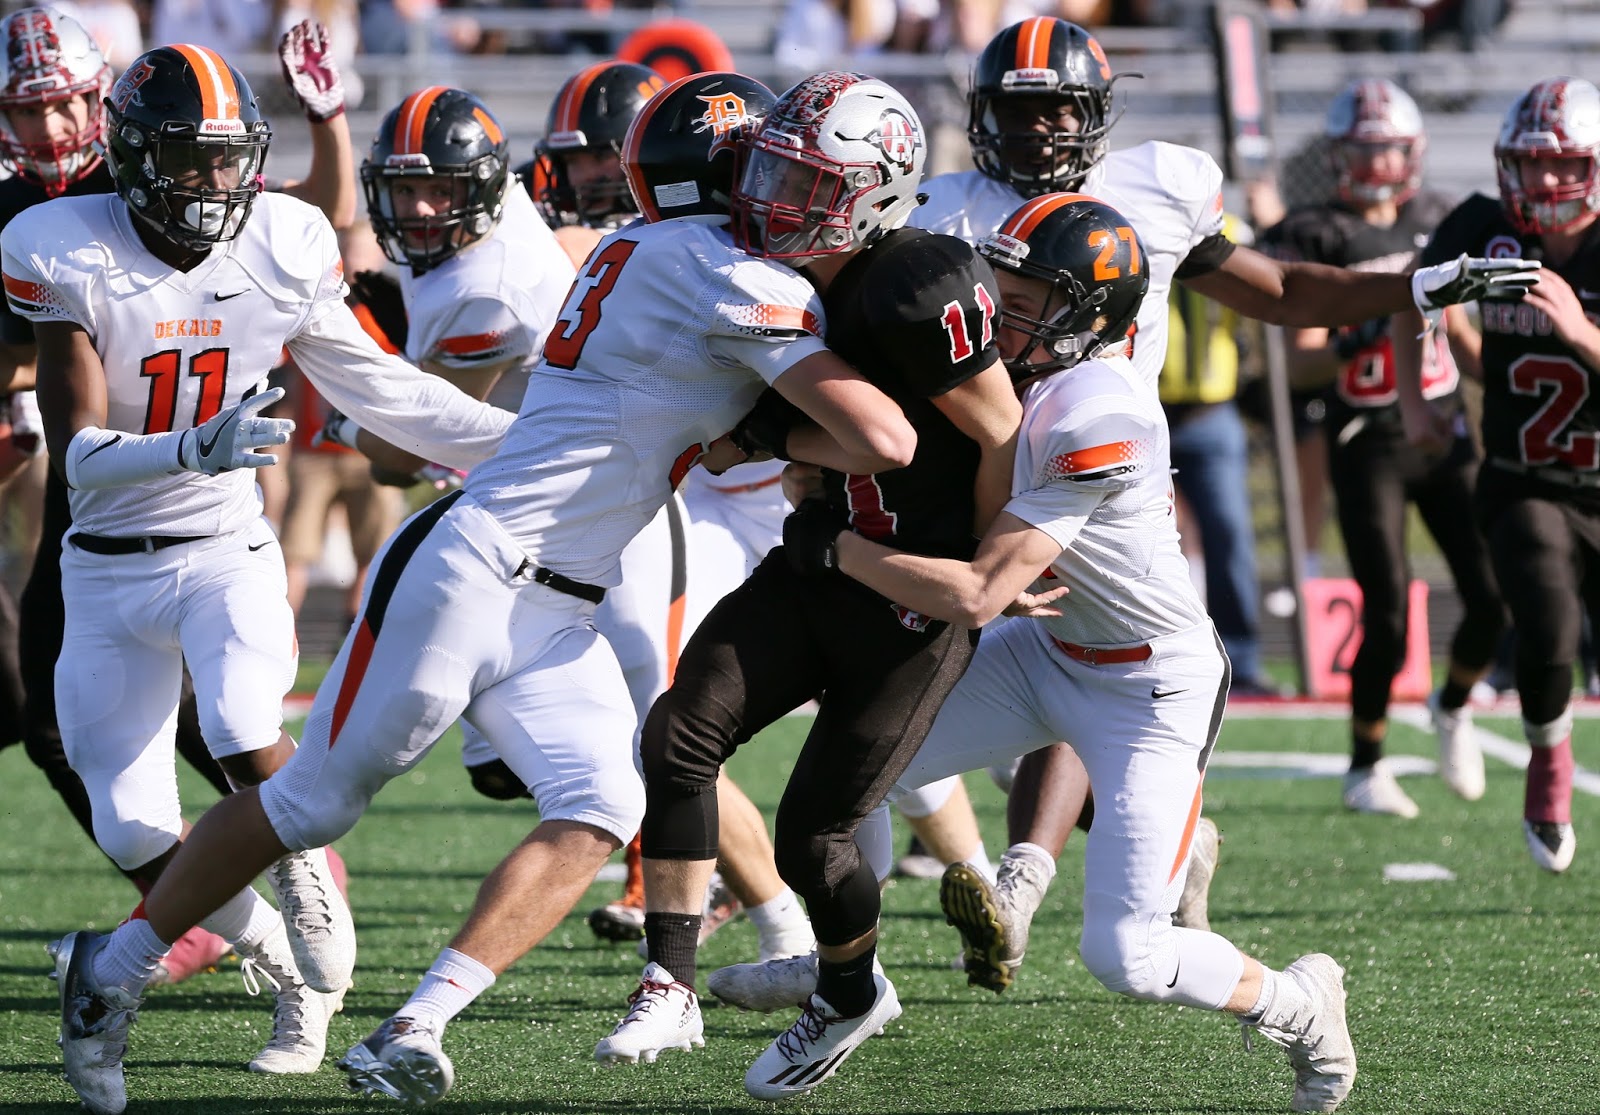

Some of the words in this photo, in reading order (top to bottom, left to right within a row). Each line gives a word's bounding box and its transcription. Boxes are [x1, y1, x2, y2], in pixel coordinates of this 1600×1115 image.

[205, 122, 242, 132] Riddell
[1087, 226, 1140, 281] 27
[154, 319, 223, 339] DEKALB
[940, 282, 996, 364] 11
[140, 347, 230, 436] 11
[1508, 353, 1599, 471] 2
